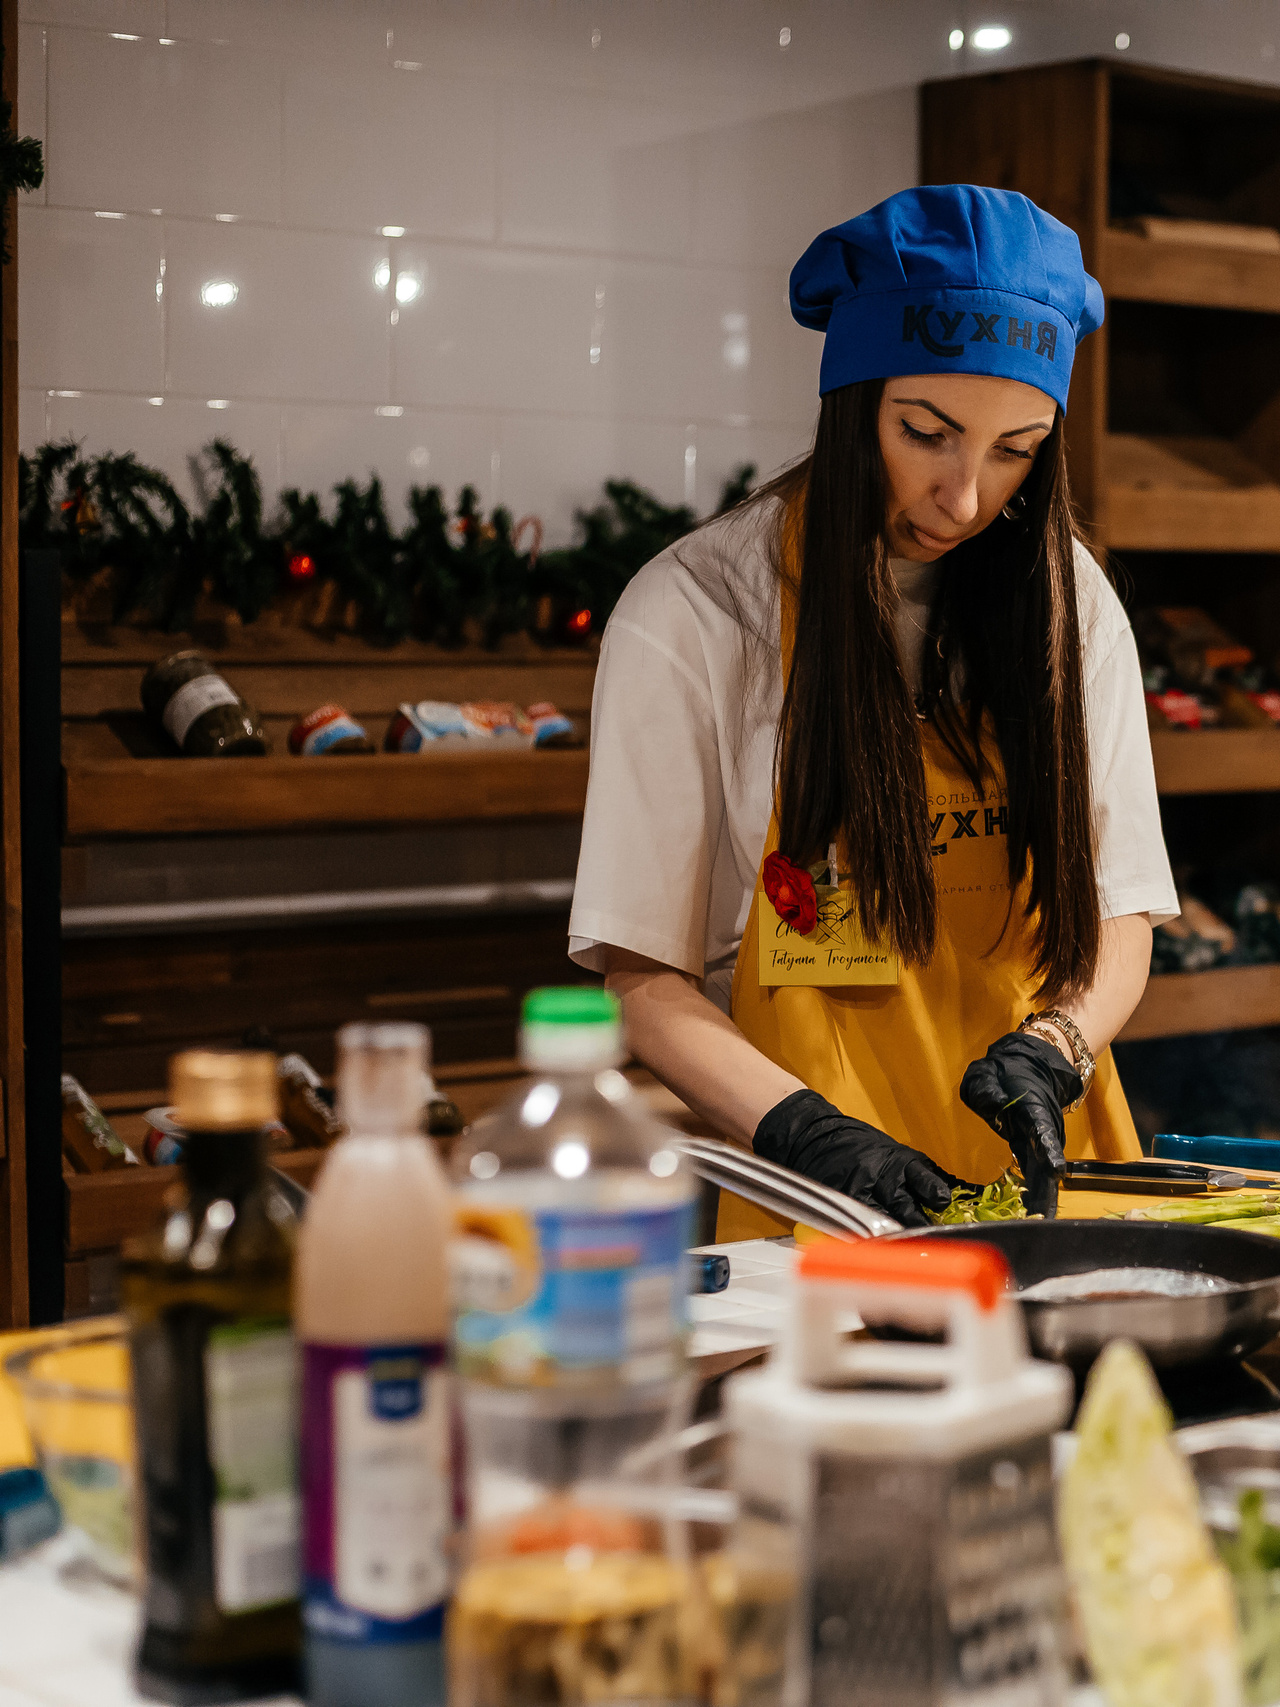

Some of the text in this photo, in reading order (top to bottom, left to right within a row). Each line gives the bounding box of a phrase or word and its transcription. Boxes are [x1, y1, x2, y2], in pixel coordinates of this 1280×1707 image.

[902, 304, 1058, 362] КУХНЯ
[930, 805, 1008, 857] УХН
[942, 885, 982, 895] АРНАЯ
[769, 948, 888, 971] Tatyana Troyanova
